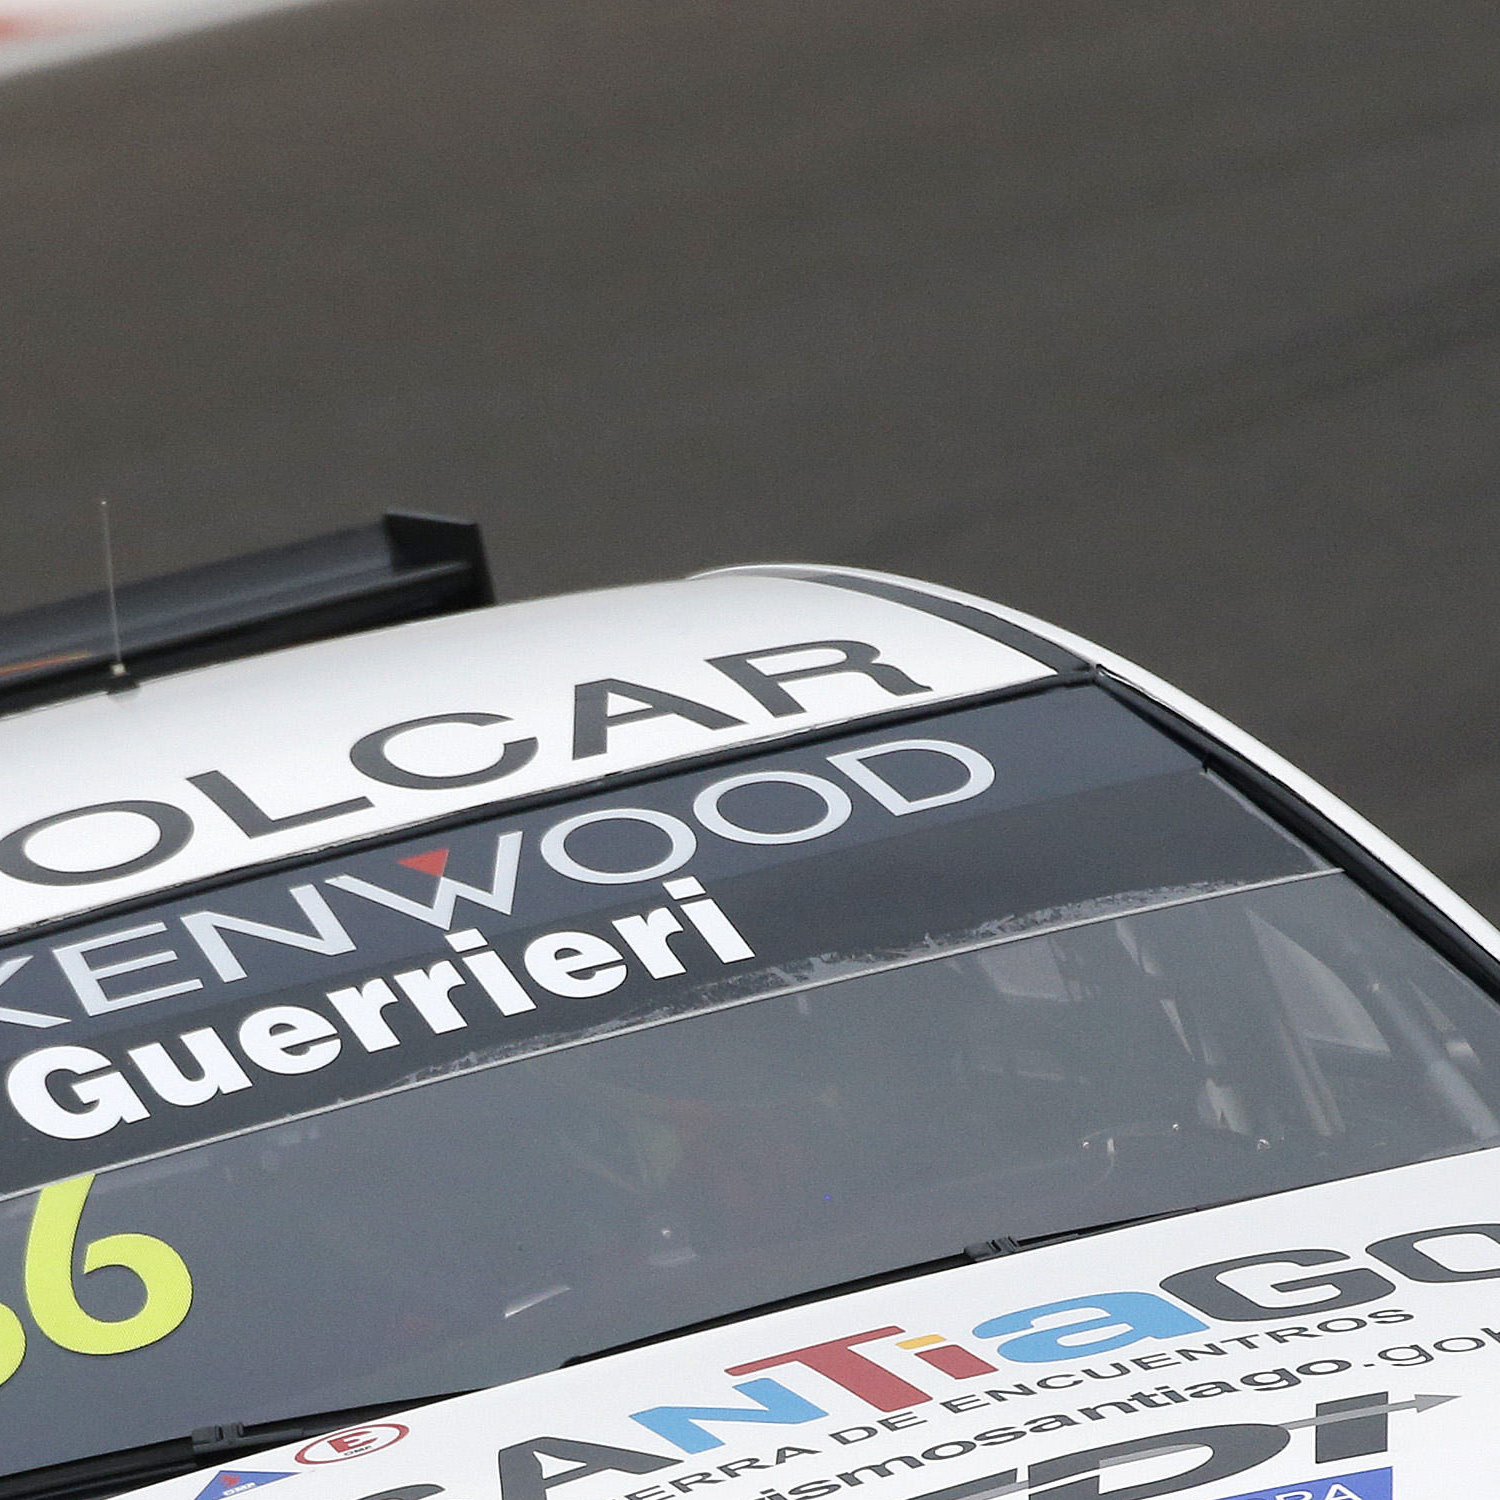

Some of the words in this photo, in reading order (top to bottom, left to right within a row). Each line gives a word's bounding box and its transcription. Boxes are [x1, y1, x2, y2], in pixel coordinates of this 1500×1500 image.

[4, 877, 757, 1141] Guerrieri
[827, 1410, 929, 1446] DE
[940, 1307, 1416, 1415] ENCUENTROS
